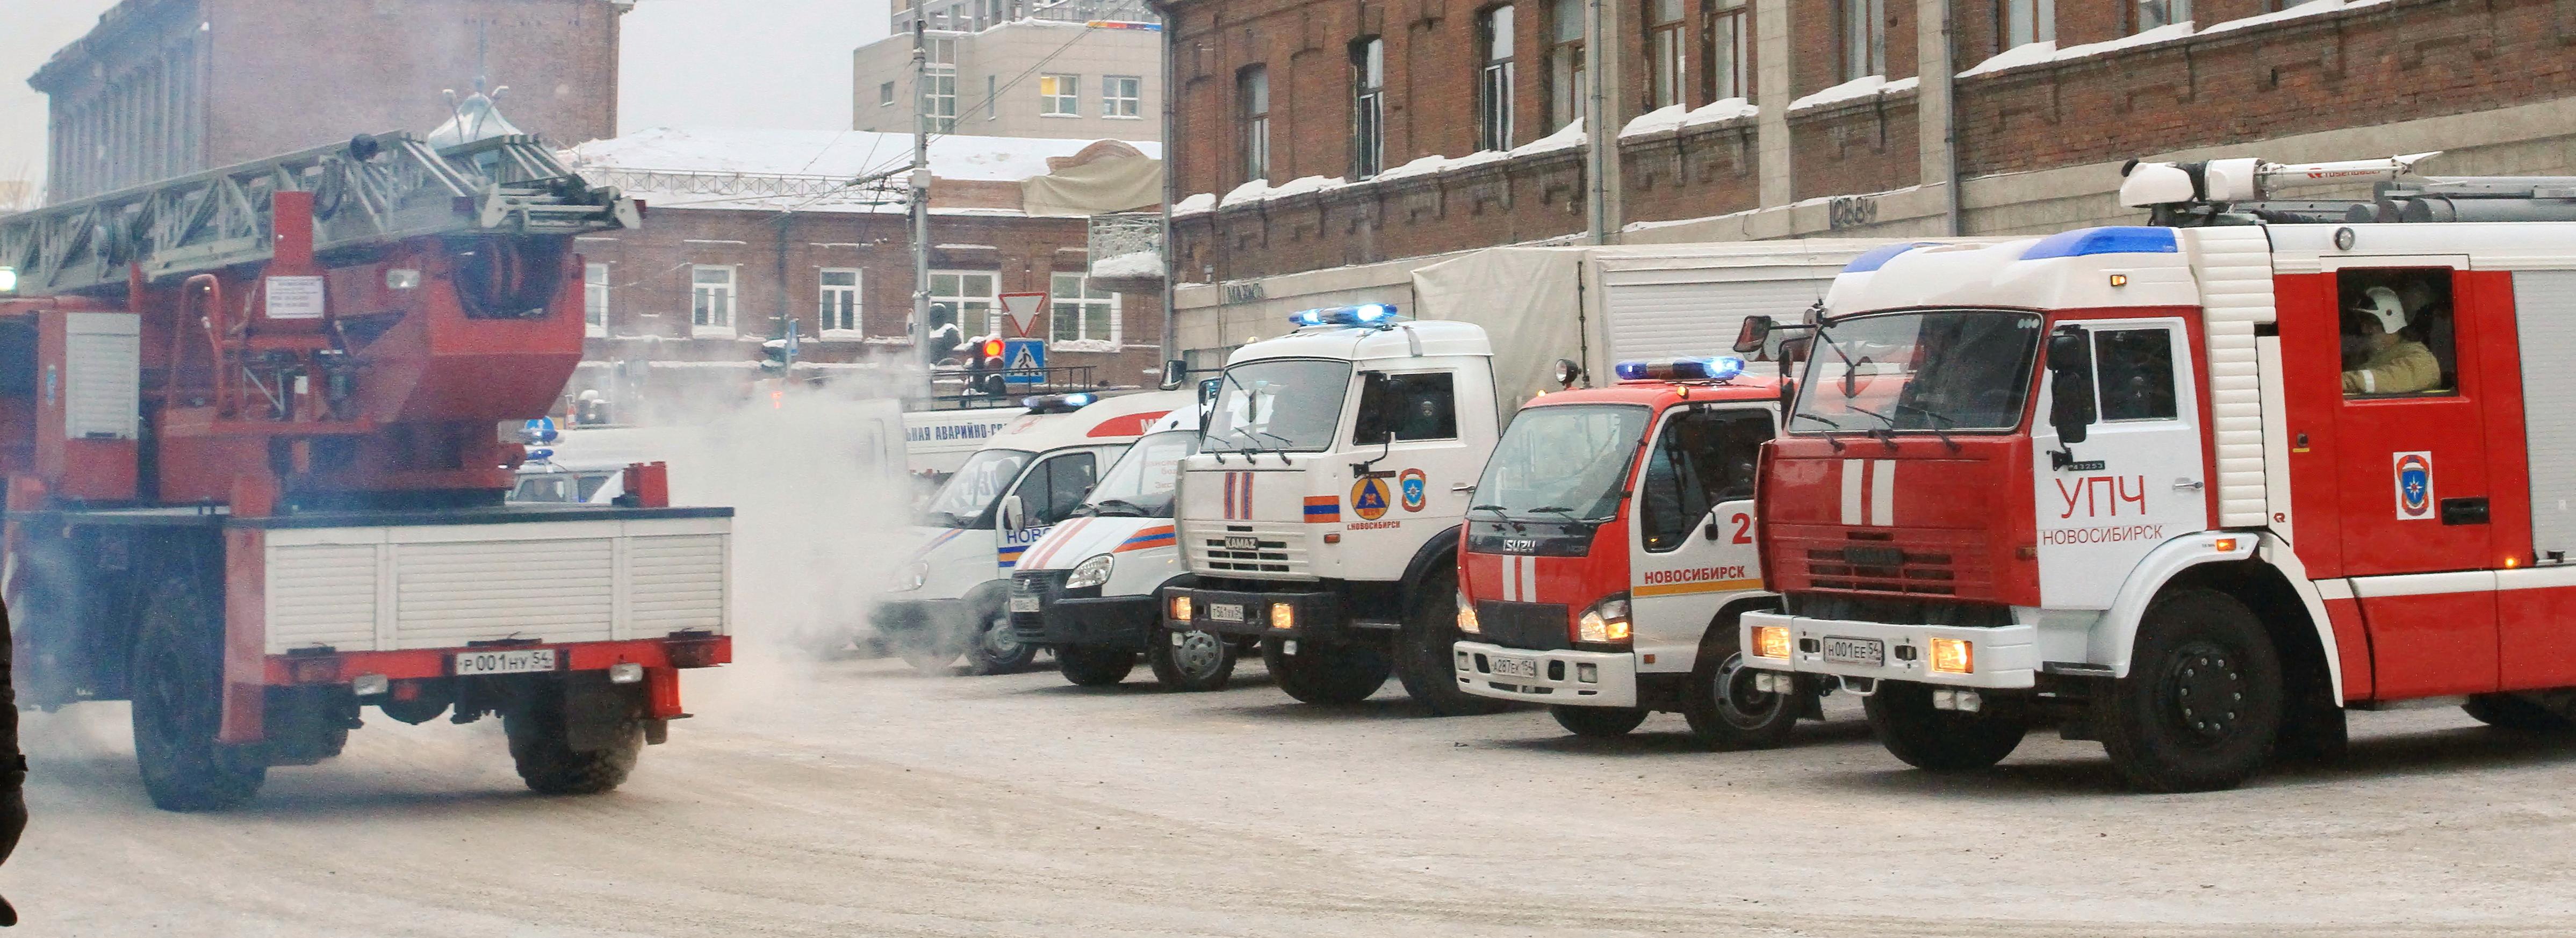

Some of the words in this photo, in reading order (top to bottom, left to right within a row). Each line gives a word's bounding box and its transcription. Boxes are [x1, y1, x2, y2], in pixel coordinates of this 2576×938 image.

[936, 422, 1008, 440] АВАРИЙНО-СП
[2055, 475, 2146, 519] УПЧ
[1731, 513, 1752, 544] 2
[2043, 525, 2163, 546] НОВОСИБИРСК
[1225, 538, 1256, 549] KAMAZ
[1503, 539, 1536, 552] ISUZU
[1645, 565, 1745, 585] НОВОСИБИРСК
